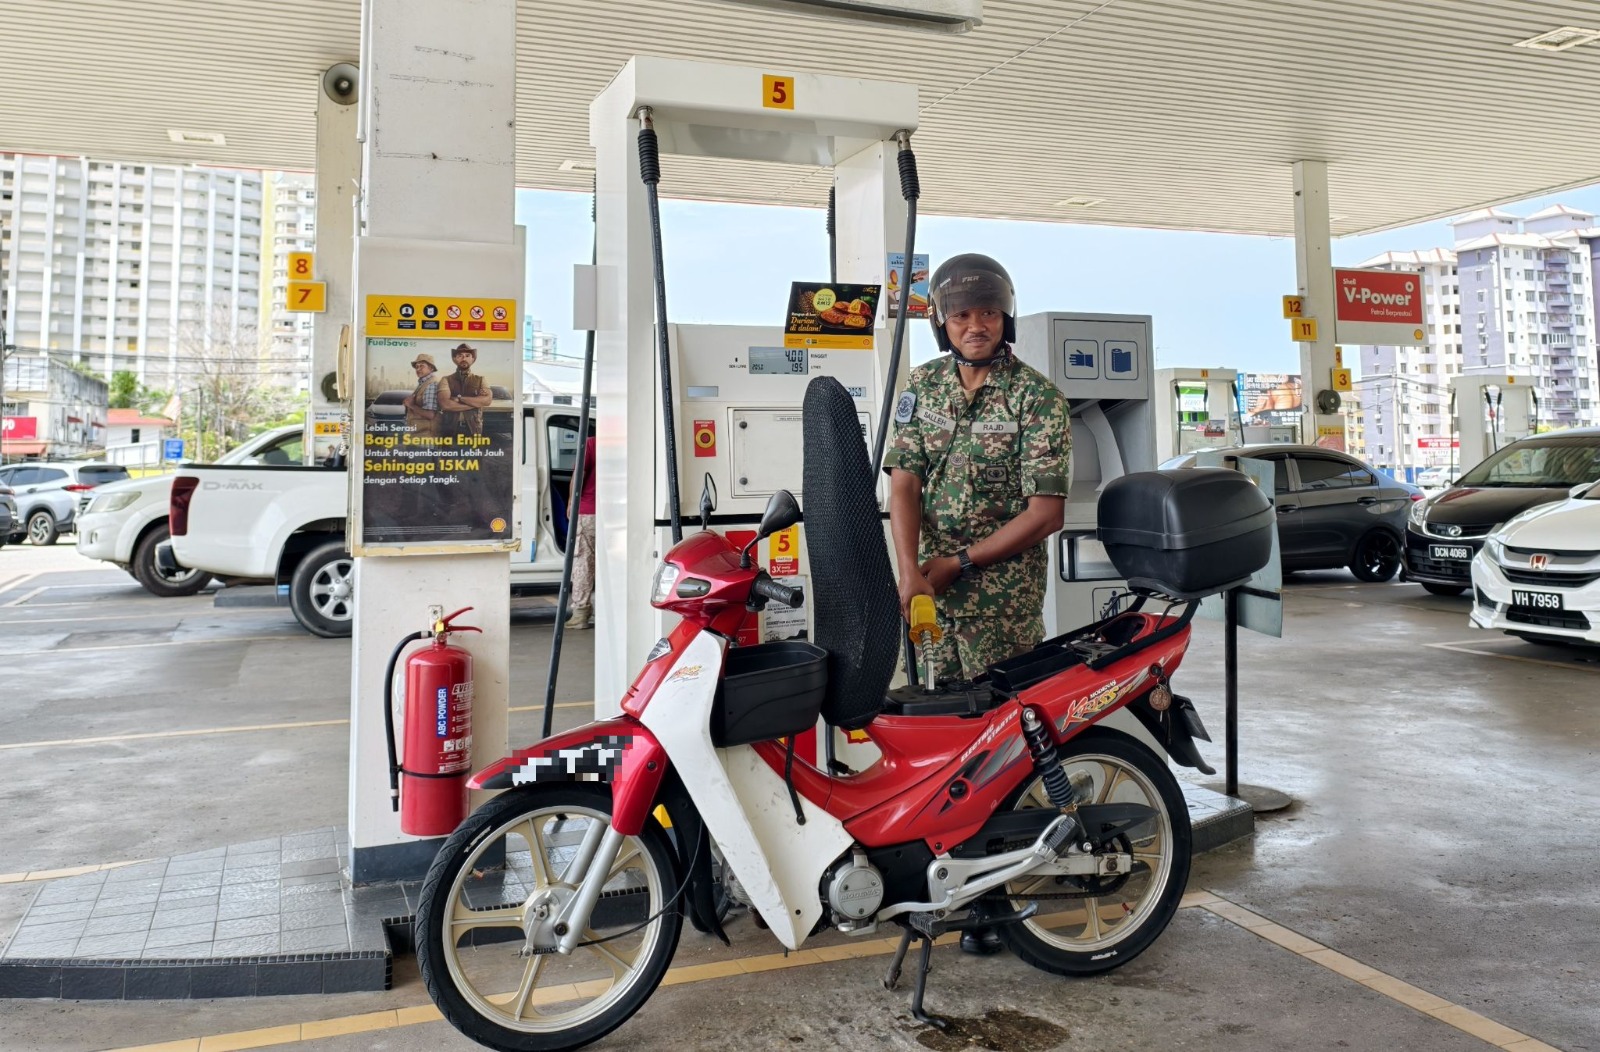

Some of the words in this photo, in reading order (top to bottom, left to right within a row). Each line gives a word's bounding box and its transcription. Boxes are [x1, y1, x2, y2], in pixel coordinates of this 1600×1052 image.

[772, 81, 787, 104] 5
[296, 258, 308, 274] 8
[298, 288, 312, 304] 7
[1344, 287, 1411, 305] V-Power
[1288, 301, 1301, 312] 12
[1371, 308, 1385, 316] Petrol
[1386, 309, 1412, 317] Berprestasi
[791, 316, 815, 324] Durian
[1302, 323, 1311, 335] 11
[368, 338, 408, 347] FuelSave
[785, 350, 803, 362] 4.00
[1339, 374, 1347, 386] 3
[923, 412, 947, 426] SALLEH
[365, 424, 388, 432] Lebih
[390, 423, 417, 432] Serasi
[365, 434, 398, 448] Bagi
[403, 434, 453, 446] Semua
[457, 434, 491, 448] Enjin
[365, 449, 390, 457] Untuk
[393, 449, 458, 459] Pengembaraan
[461, 449, 482, 457] Lebih
[484, 448, 504, 457] Jauh
[364, 459, 435, 474] Sehingga
[439, 459, 479, 471] 15KM
[364, 476, 396, 486] dengan
[399, 476, 426, 485] Setiap
[429, 475, 460, 485] Tangki.
[778, 535, 790, 552] 5
[1435, 547, 1449, 557] DCN
[1449, 548, 1467, 558] 4068
[1514, 592, 1529, 606] VH
[1531, 593, 1559, 608] 7958
[1090, 680, 1116, 698] MODENAS
[438, 688, 446, 720] POWDER
[438, 721, 446, 735] ABC
[987, 709, 1018, 744] STARTER
[961, 724, 994, 762] ELECTRIC
